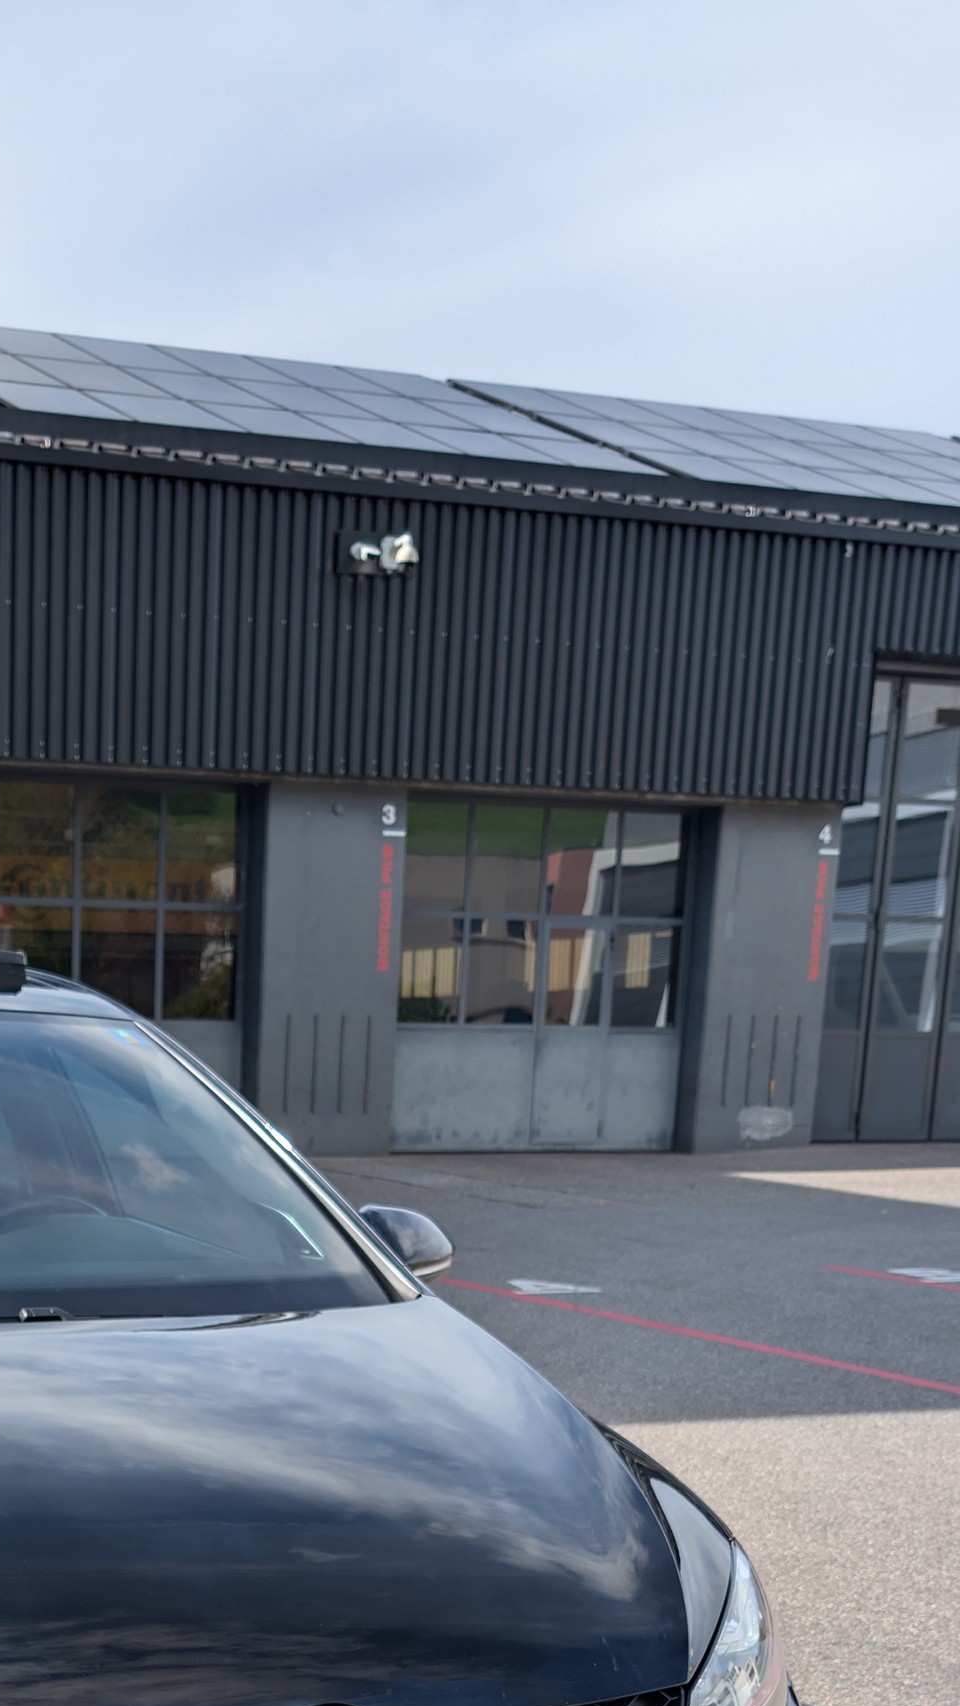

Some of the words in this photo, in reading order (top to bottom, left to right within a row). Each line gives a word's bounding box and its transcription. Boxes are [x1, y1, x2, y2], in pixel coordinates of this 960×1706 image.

[381, 804, 396, 825] 3
[818, 824, 832, 844] 4
[377, 888, 393, 972] MONTAGE
